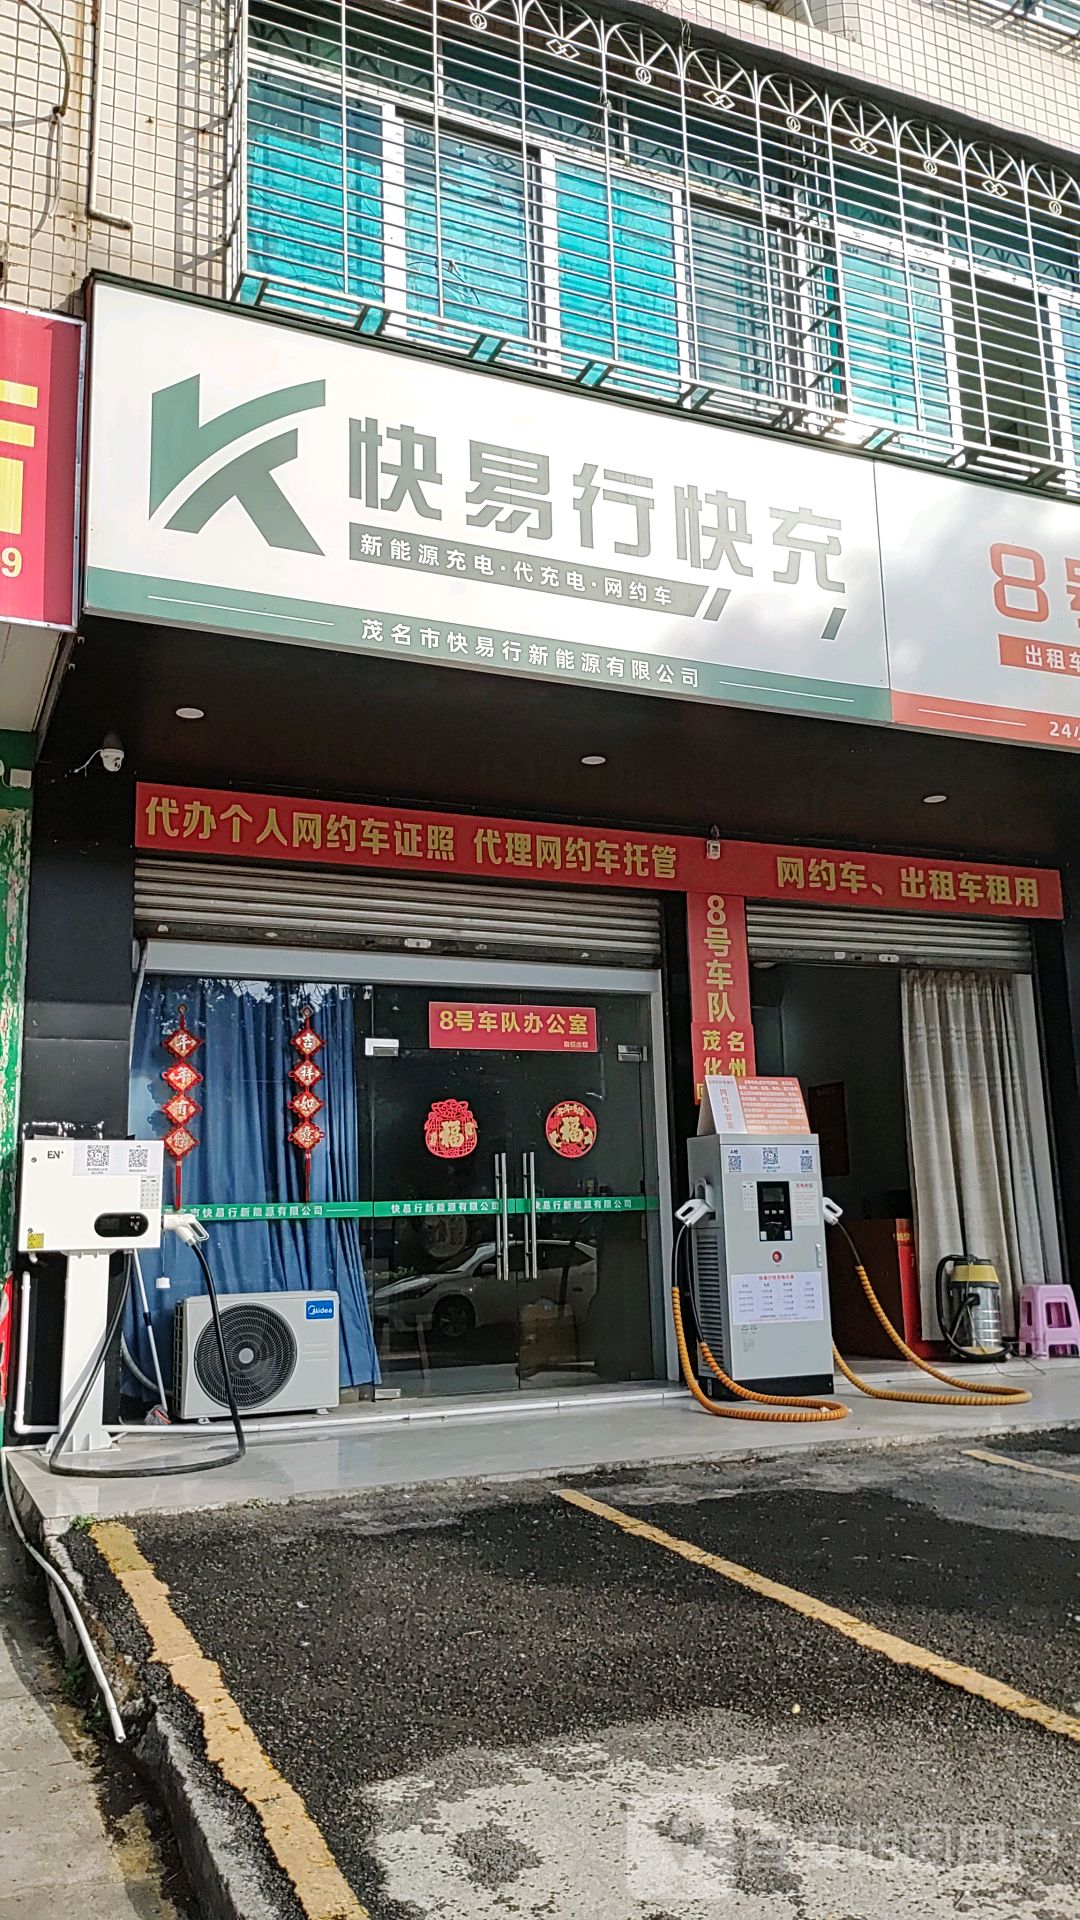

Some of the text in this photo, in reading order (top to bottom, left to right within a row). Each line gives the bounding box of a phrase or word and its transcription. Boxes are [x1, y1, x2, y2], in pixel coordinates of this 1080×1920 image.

[348, 416, 846, 594] 快易行快充
[989, 542, 1080, 628] 8
[360, 618, 699, 688] 茂名市快易行新能源有限公司
[145, 796, 677, 879] 代办个人网约车证照 代理网约车托管
[703, 895, 735, 1023] 8号车队
[439, 1010, 589, 1036] 8号车队办公室
[702, 1029, 745, 1052] 茂名
[439, 1120, 465, 1148] 福
[560, 1116, 584, 1143] 福
[307, 1304, 333, 1315] Midea
